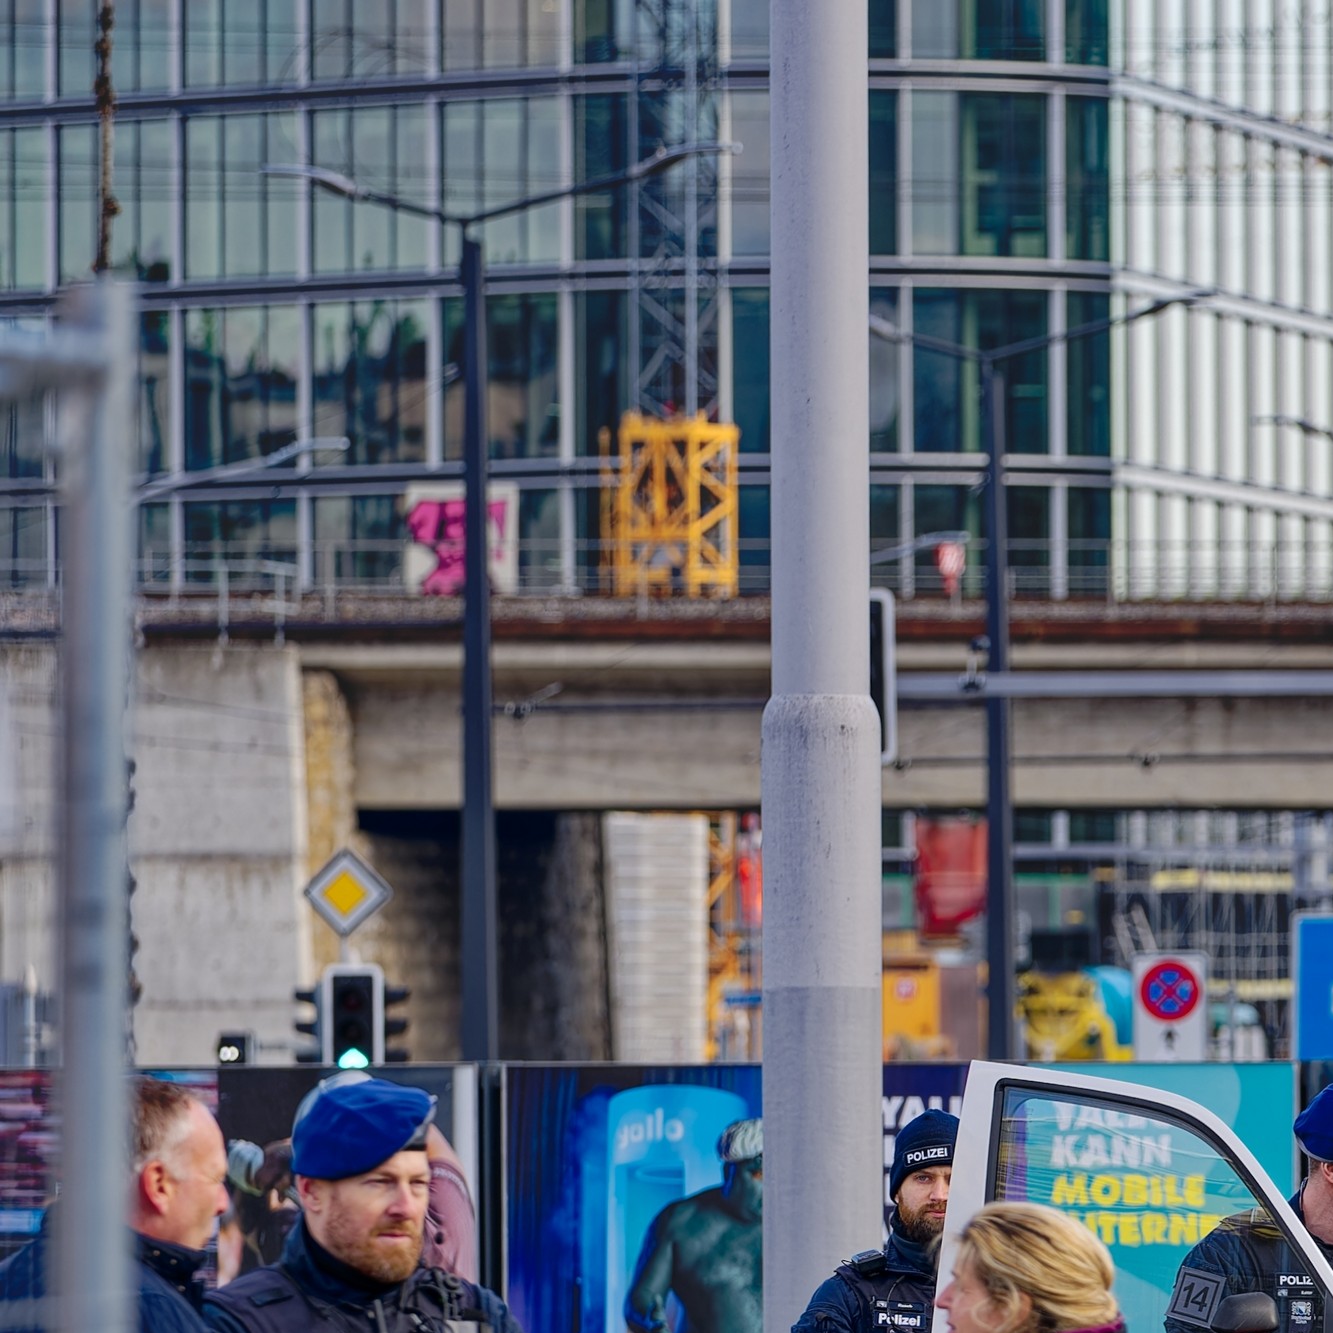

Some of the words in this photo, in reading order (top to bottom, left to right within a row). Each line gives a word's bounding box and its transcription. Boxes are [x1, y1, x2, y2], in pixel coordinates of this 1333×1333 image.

[617, 1107, 685, 1150] yallo
[906, 1147, 949, 1165] POLIZEI
[1050, 1133, 1172, 1169] KANN
[1051, 1172, 1206, 1208] MOBILE
[1183, 1281, 1212, 1313] 14
[878, 1312, 921, 1327] Polizei
